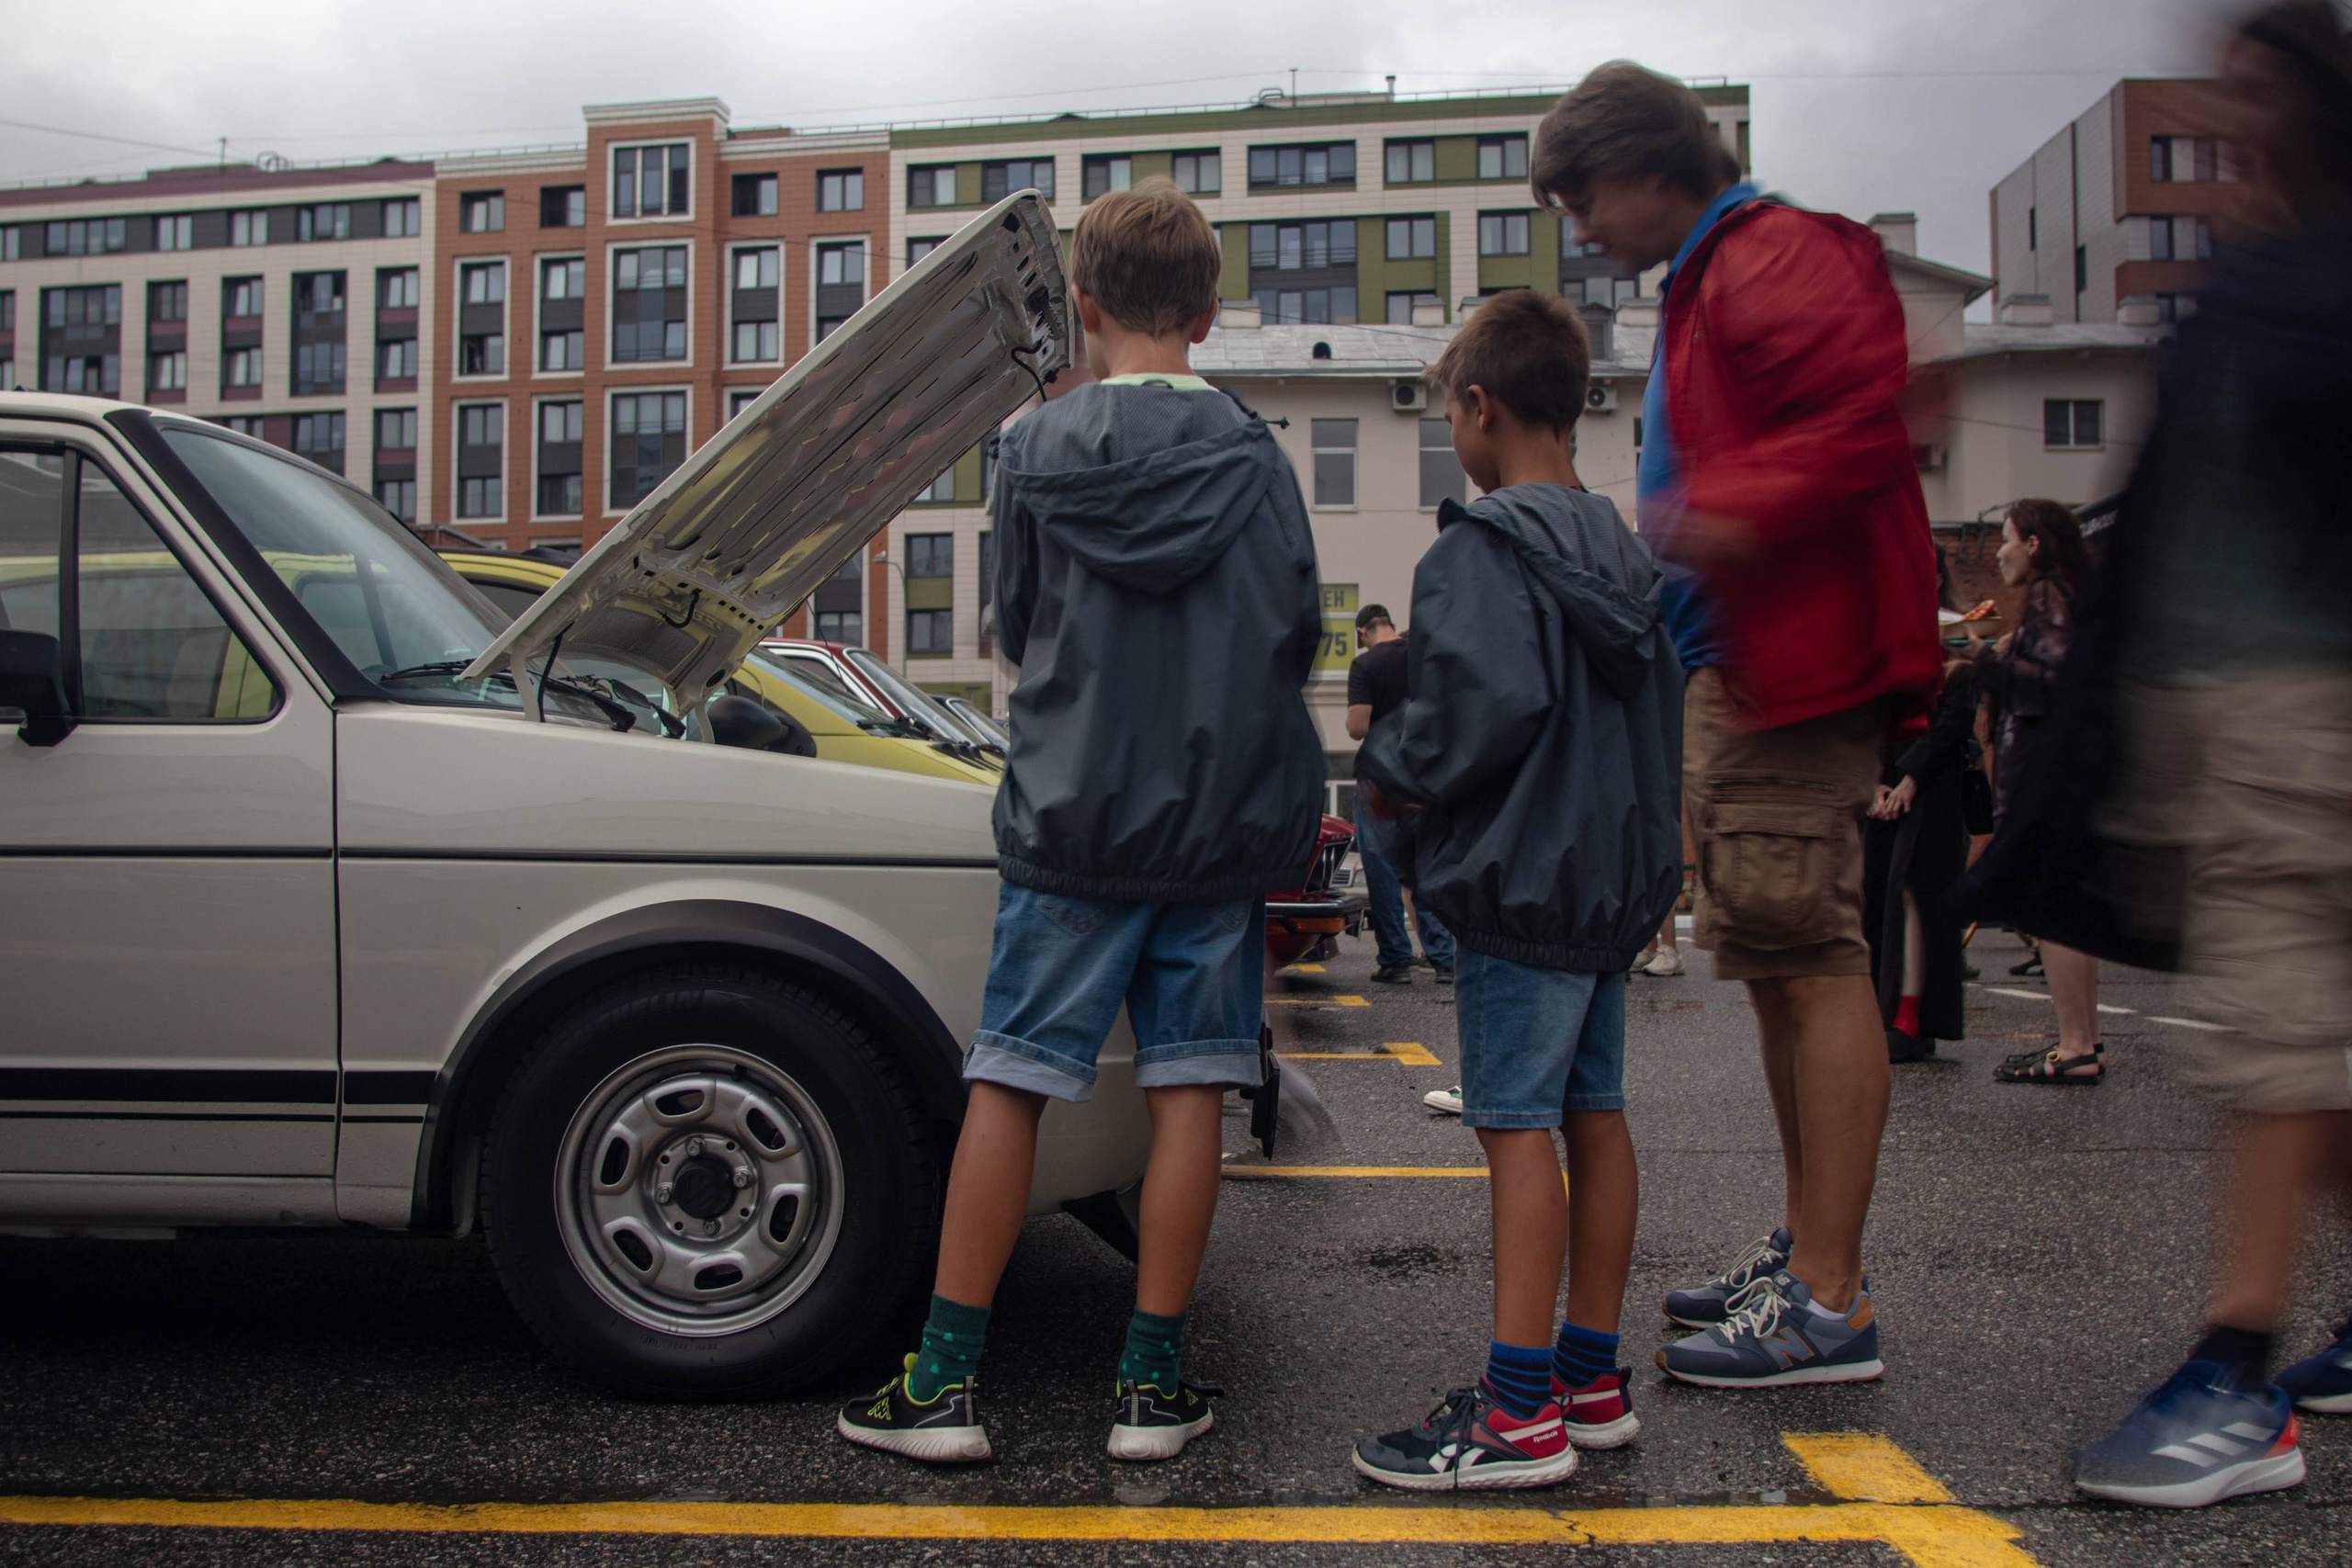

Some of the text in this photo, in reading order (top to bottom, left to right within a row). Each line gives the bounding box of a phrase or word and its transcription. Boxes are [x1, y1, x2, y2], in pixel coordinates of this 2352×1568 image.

[1322, 632, 1347, 657] 75
[1758, 1325, 1815, 1371] N
[1532, 1430, 1559, 1443] Reebok
